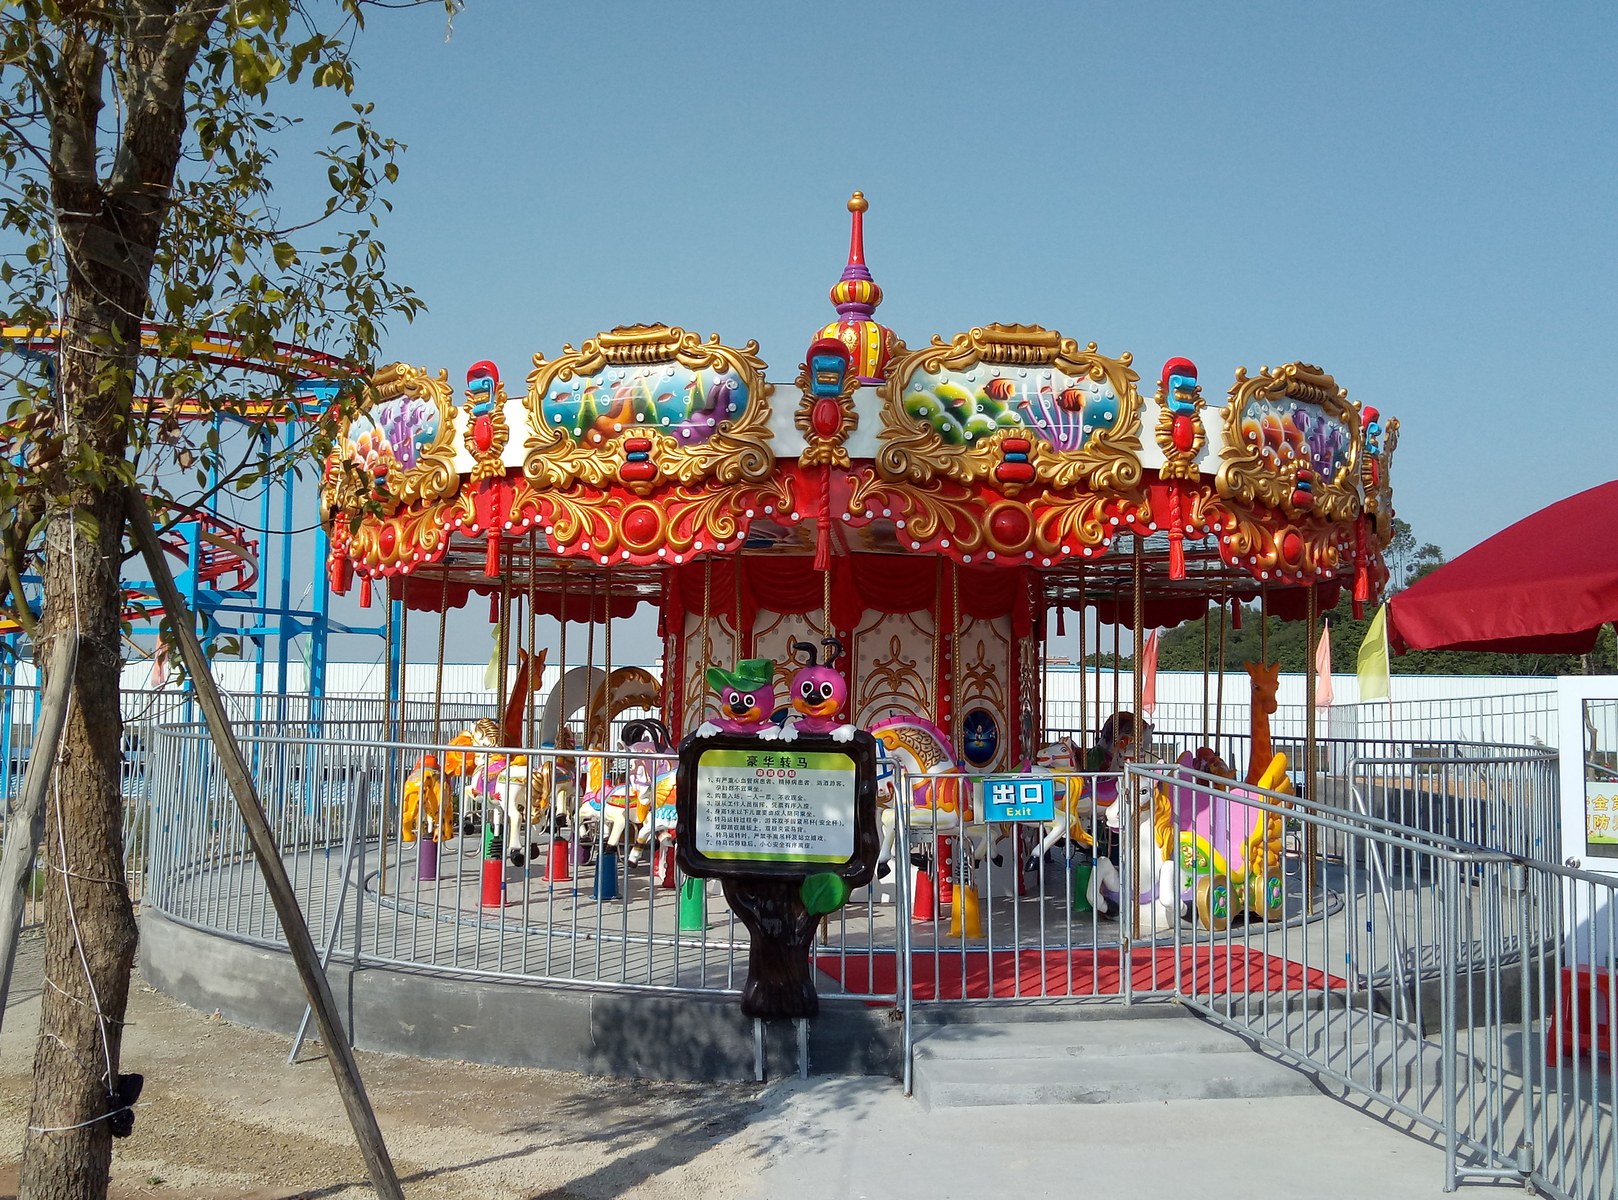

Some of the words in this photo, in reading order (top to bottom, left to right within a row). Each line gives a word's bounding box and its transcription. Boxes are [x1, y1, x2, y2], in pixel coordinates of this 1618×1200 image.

[746, 755, 808, 768] 豪华转马
[992, 784, 1043, 805] 出口
[1006, 807, 1032, 816] Exit
